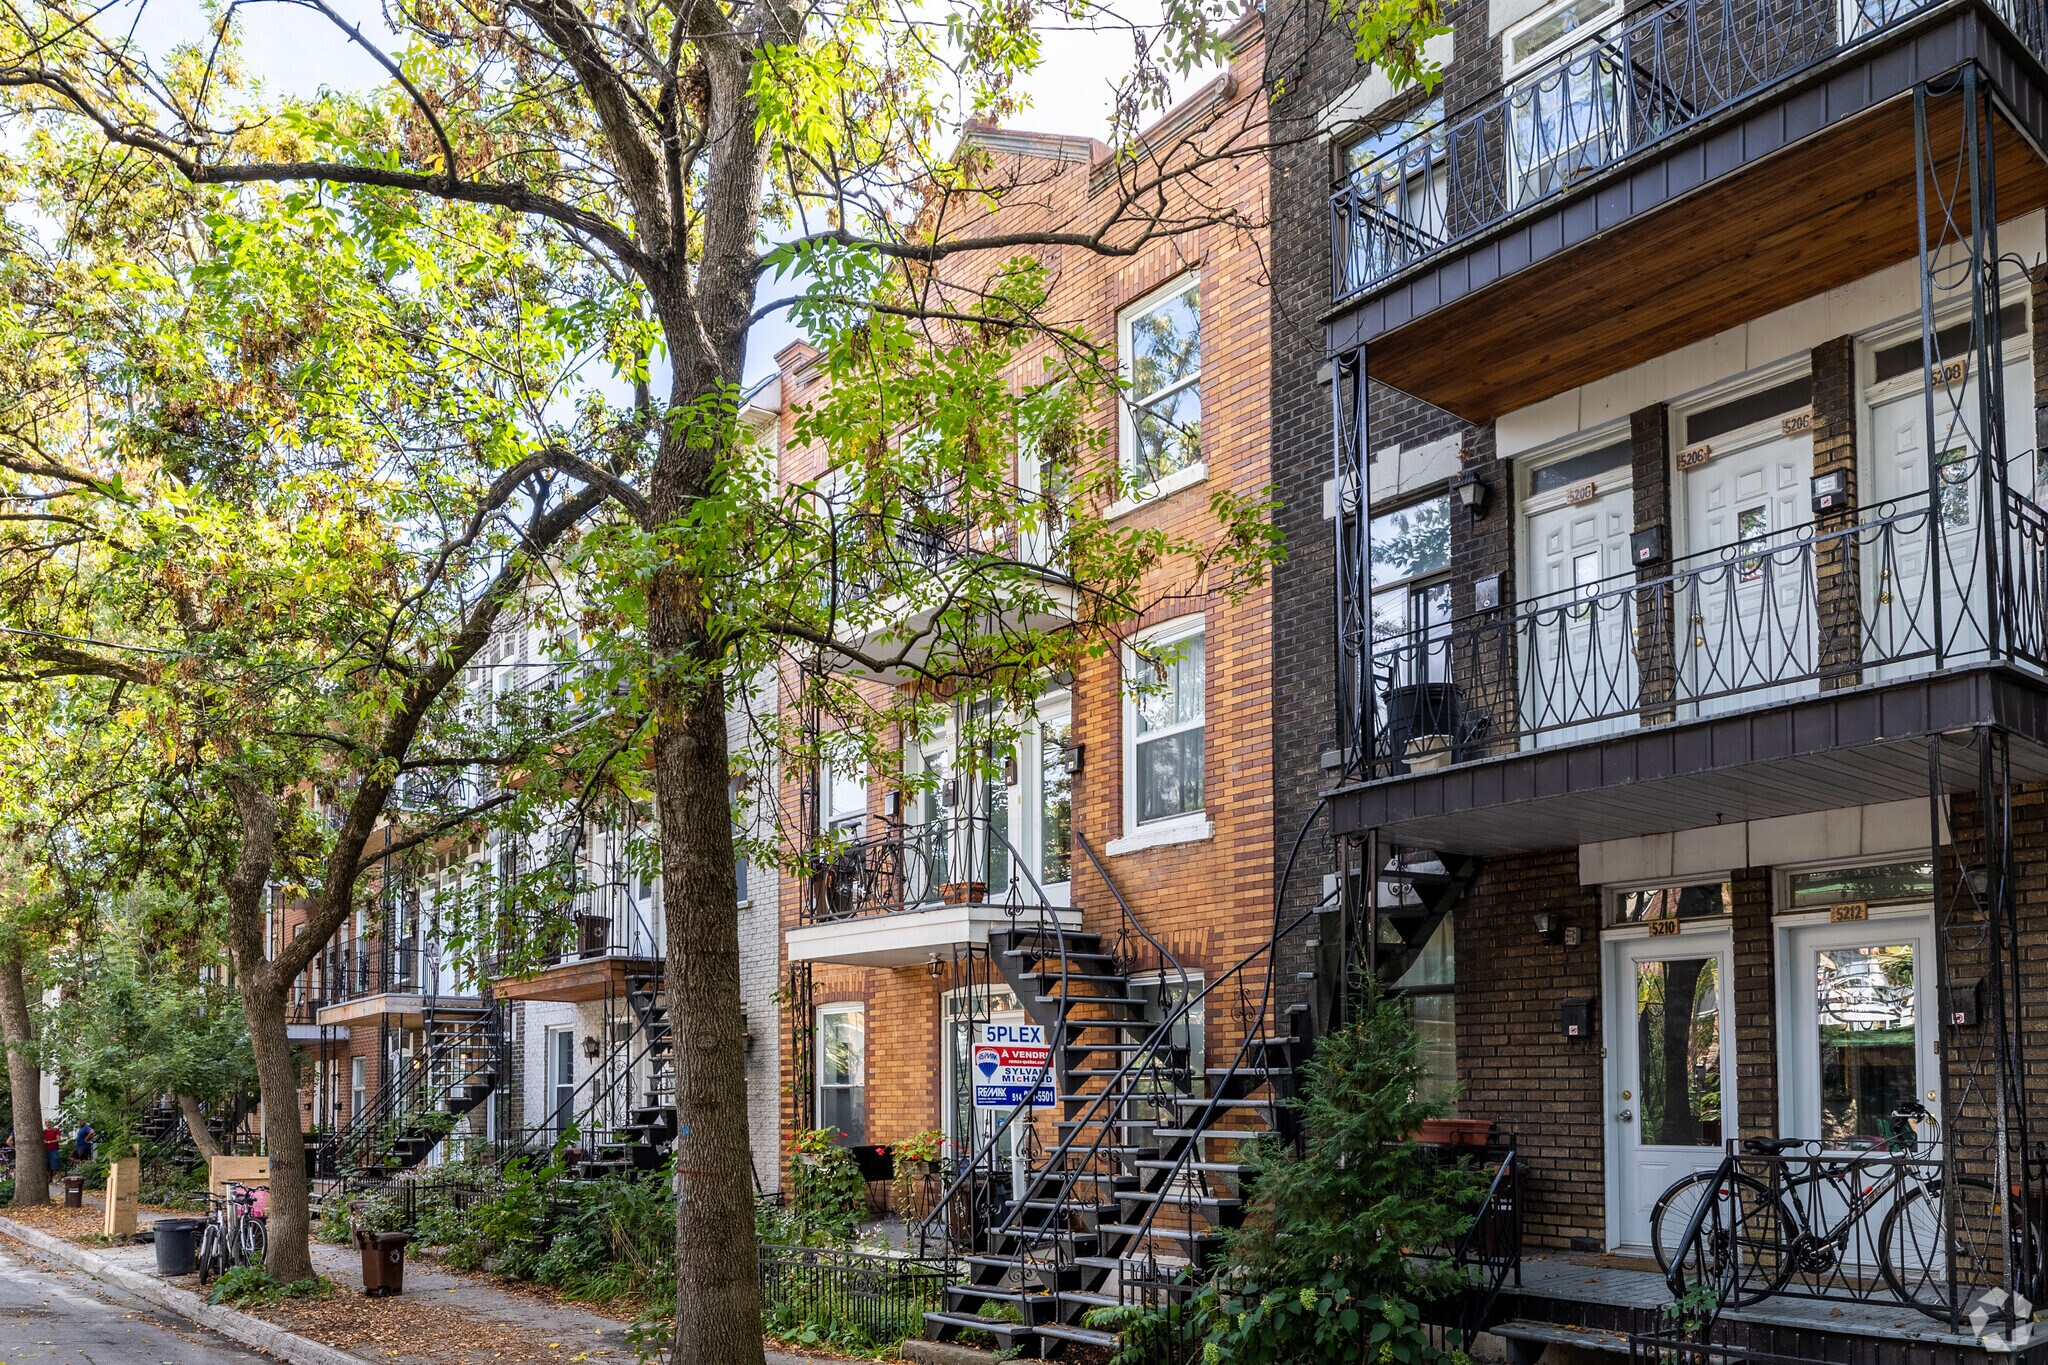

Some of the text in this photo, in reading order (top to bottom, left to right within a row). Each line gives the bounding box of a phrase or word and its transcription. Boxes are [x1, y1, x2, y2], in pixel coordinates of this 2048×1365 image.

[1784, 414, 1810, 434] 5206
[1679, 448, 1704, 468] 5206
[1567, 485, 1591, 503] 5206
[1836, 904, 1862, 921] 5212
[1652, 920, 1675, 935] 5210
[986, 1026, 1041, 1043] 5PLEX
[1001, 1049, 1009, 1058] À
[977, 1087, 1007, 1097] RE/MAX
[1012, 1093, 1022, 1102] 514
